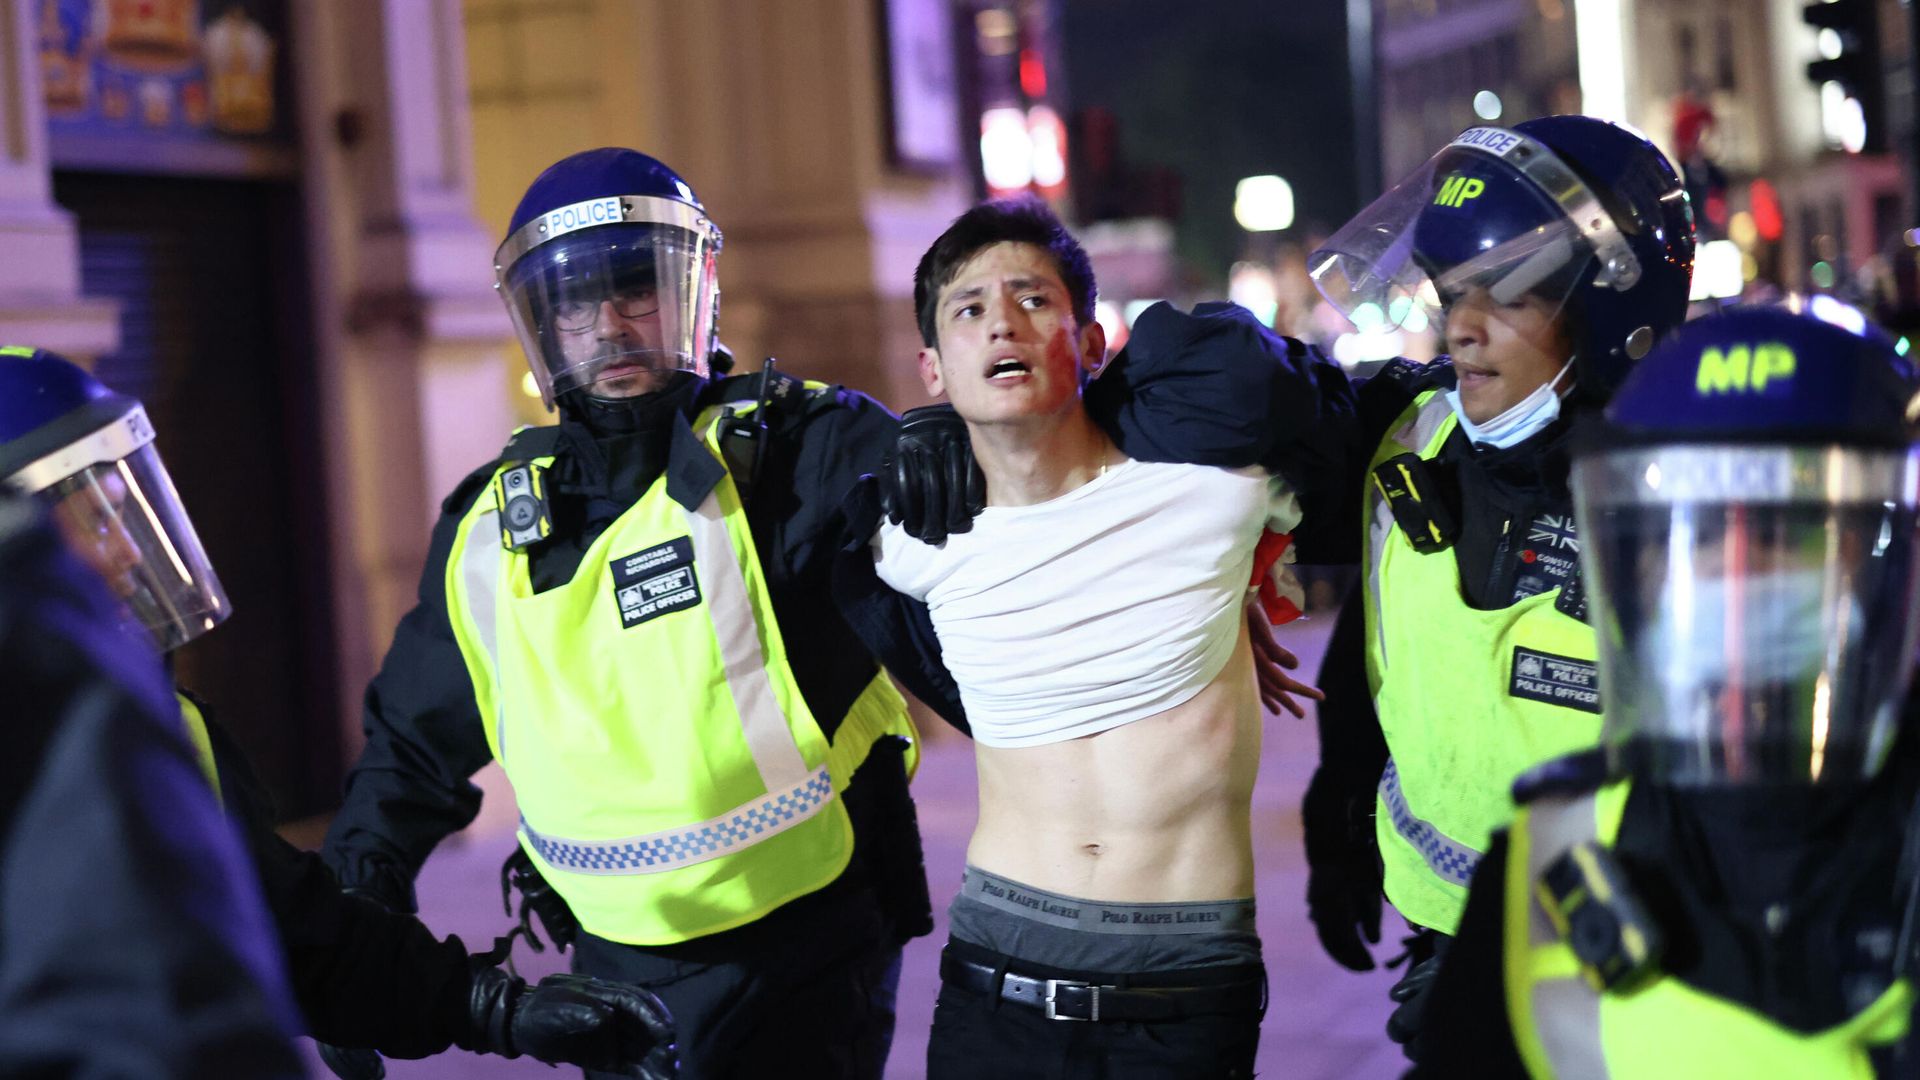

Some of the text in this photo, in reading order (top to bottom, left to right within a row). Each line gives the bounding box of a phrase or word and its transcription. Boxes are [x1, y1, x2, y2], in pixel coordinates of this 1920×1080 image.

[1459, 129, 1516, 152] POLICE
[1433, 176, 1486, 208] MP
[552, 201, 617, 232] POLICE
[1695, 341, 1797, 394] MP
[650, 578, 683, 596] POLICE
[624, 590, 696, 621] POLICE OFFICER
[1516, 679, 1553, 696] POLICE
[1552, 671, 1589, 685] POLICE
